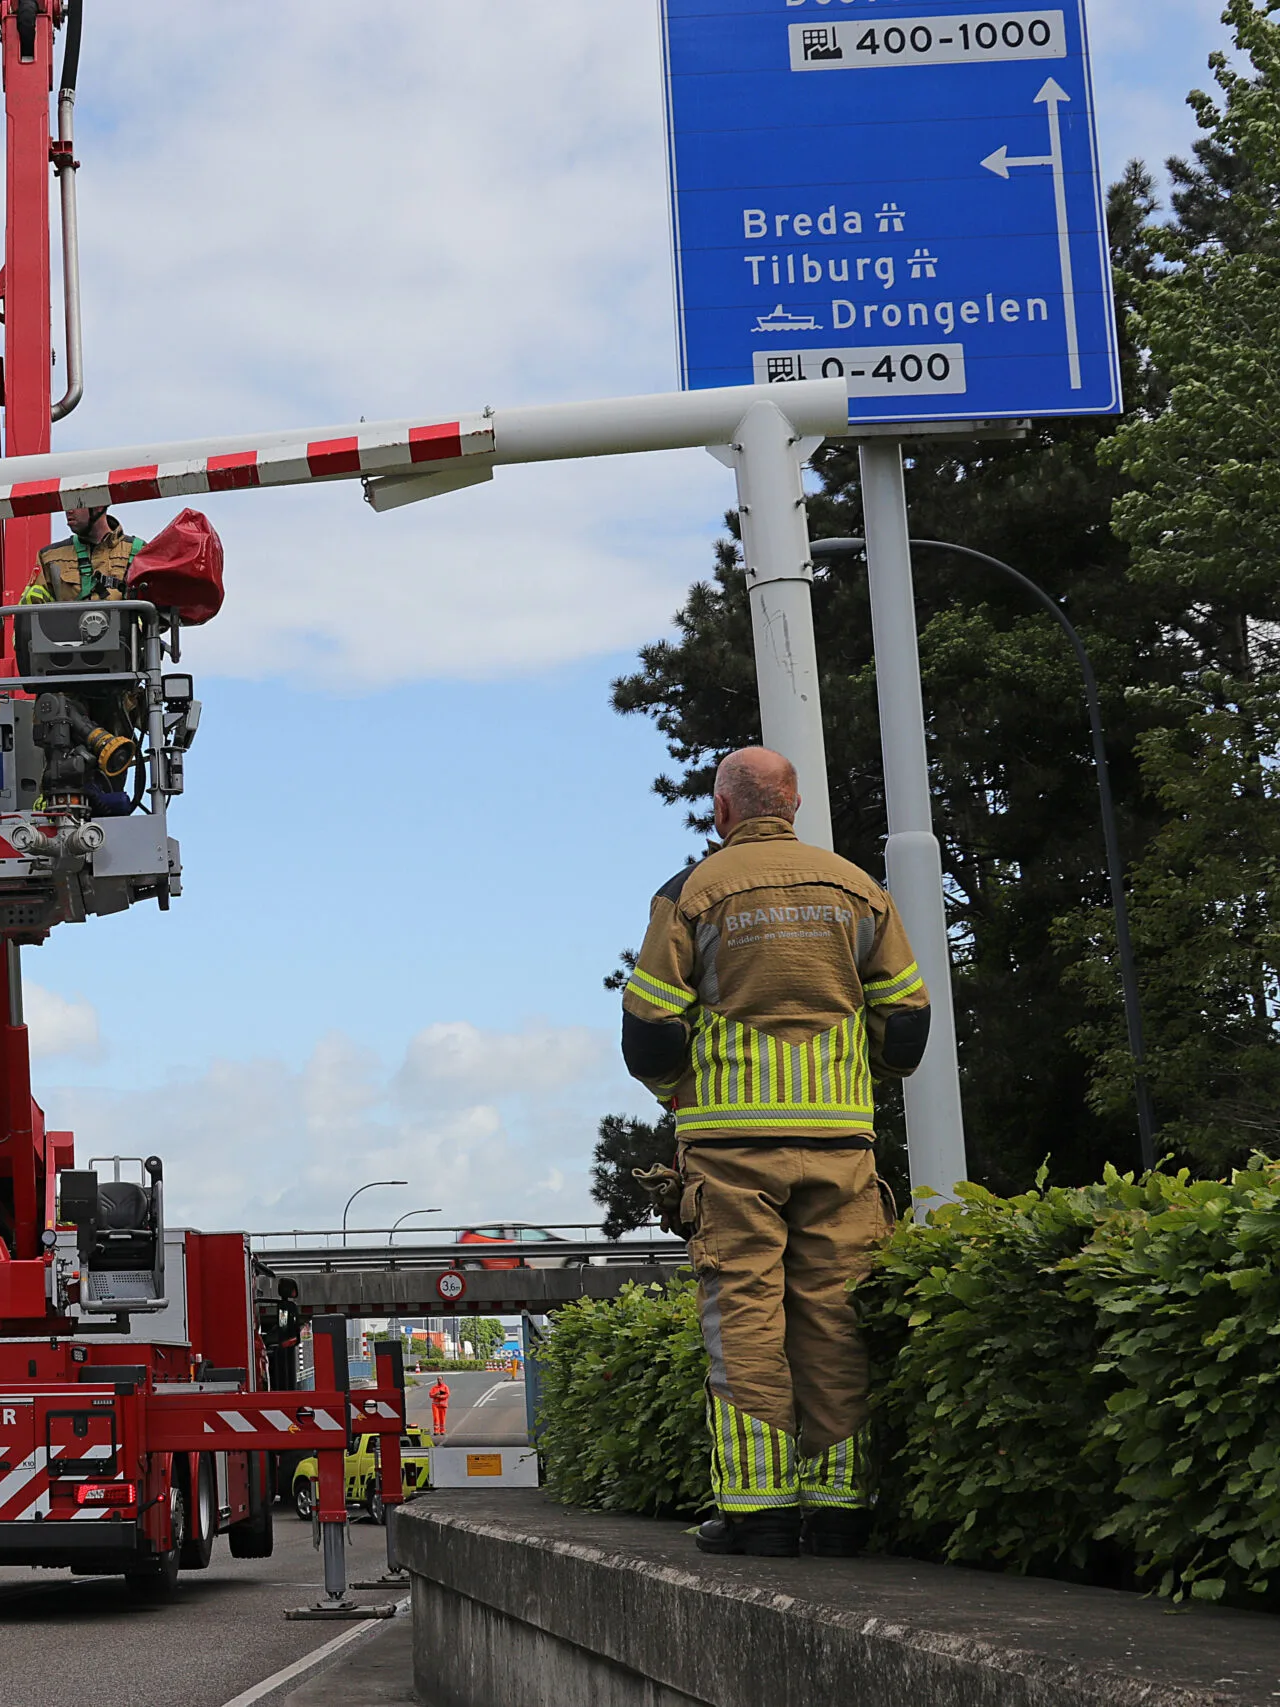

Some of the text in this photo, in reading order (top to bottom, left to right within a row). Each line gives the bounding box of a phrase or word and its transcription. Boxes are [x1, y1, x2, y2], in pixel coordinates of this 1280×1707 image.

[856, 19, 1051, 55] 400-1000
[743, 204, 862, 239] Breda
[743, 253, 895, 290] Tilburg
[831, 292, 1048, 335] Drongelen
[821, 353, 950, 383] 0-400
